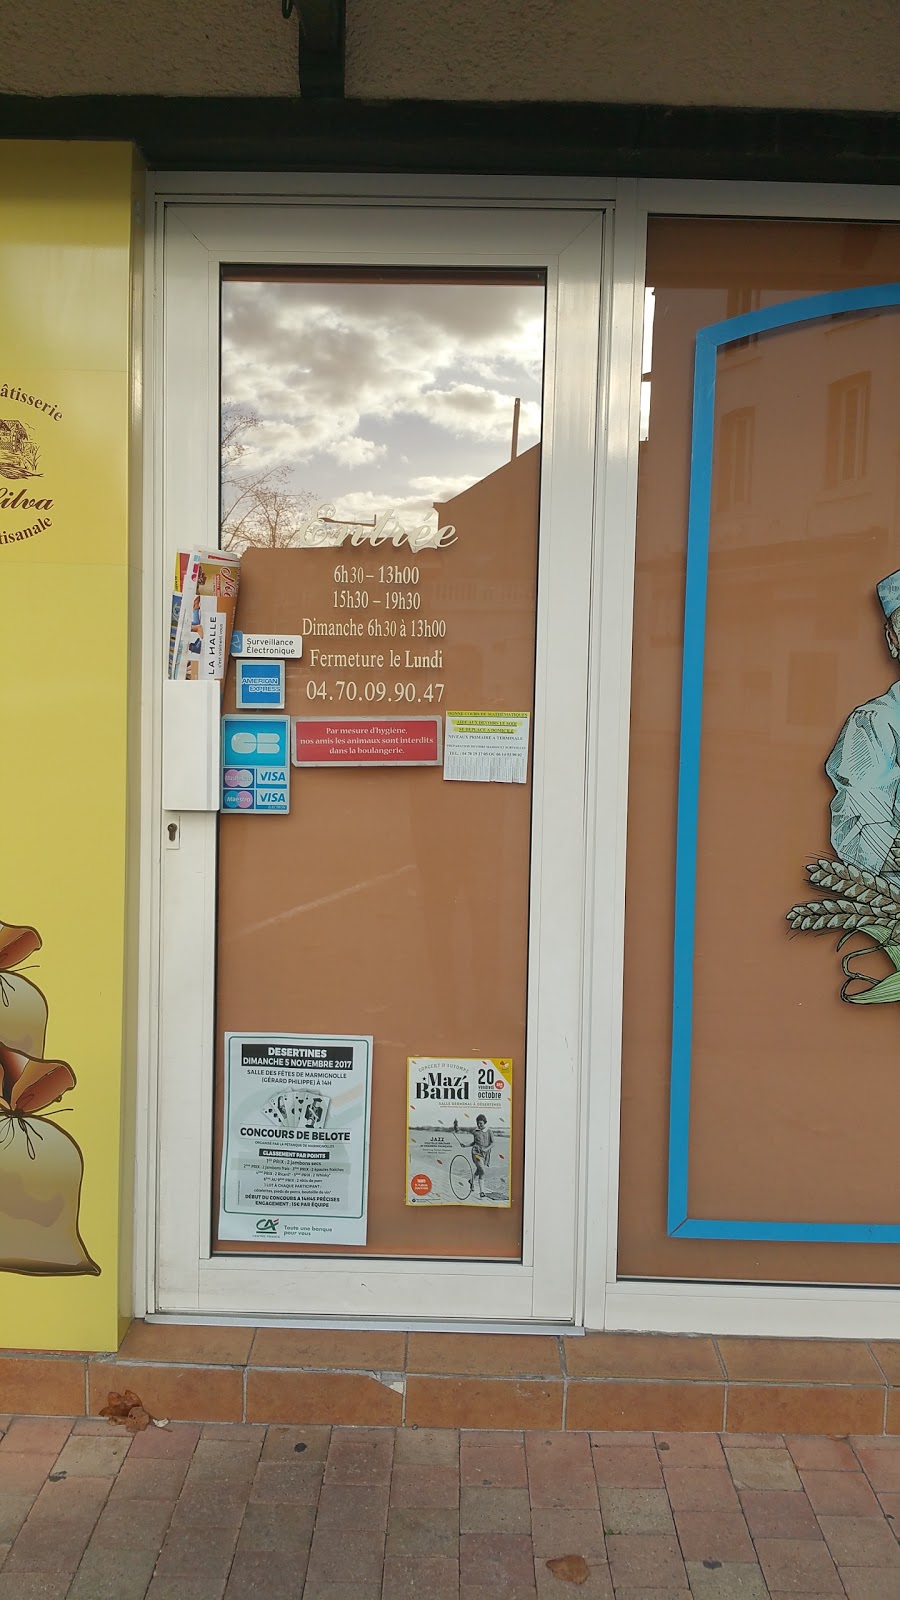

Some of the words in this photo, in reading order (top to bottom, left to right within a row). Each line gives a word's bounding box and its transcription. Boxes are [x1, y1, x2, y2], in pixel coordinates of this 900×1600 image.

[302, 503, 458, 547] Entrée
[334, 565, 364, 584] 6h30
[379, 566, 420, 584] 13h00
[333, 590, 369, 608] 15h30
[385, 592, 421, 609] 19h30
[302, 618, 364, 636] Dimanche
[368, 619, 396, 637] 6h30
[400, 619, 406, 637] à
[411, 620, 446, 637] 13h00
[247, 645, 295, 655] Électronique
[310, 649, 384, 667] Fermeture
[390, 650, 401, 667] le
[405, 650, 442, 668] Lundi
[209, 661, 215, 674] LA
[306, 680, 445, 702] 04.70.09.90.47
[231, 732, 280, 754] CB
[358, 747, 405, 755] boulangerie.
[260, 772, 285, 781] VISA
[260, 793, 285, 802] VISA
[268, 1047, 327, 1058] DESERTINES
[243, 1057, 284, 1066] DIMANCHE
[291, 1059, 333, 1068] NOVEMBRE
[335, 1060, 352, 1068] 2017
[278, 1069, 295, 1077] FÊTES
[478, 1069, 494, 1084] 20
[416, 1082, 469, 1099] Band
[478, 1091, 501, 1099] octobre
[240, 1127, 294, 1139] CONCOURS
[296, 1131, 309, 1140] DE
[312, 1131, 350, 1140] BELOTE
